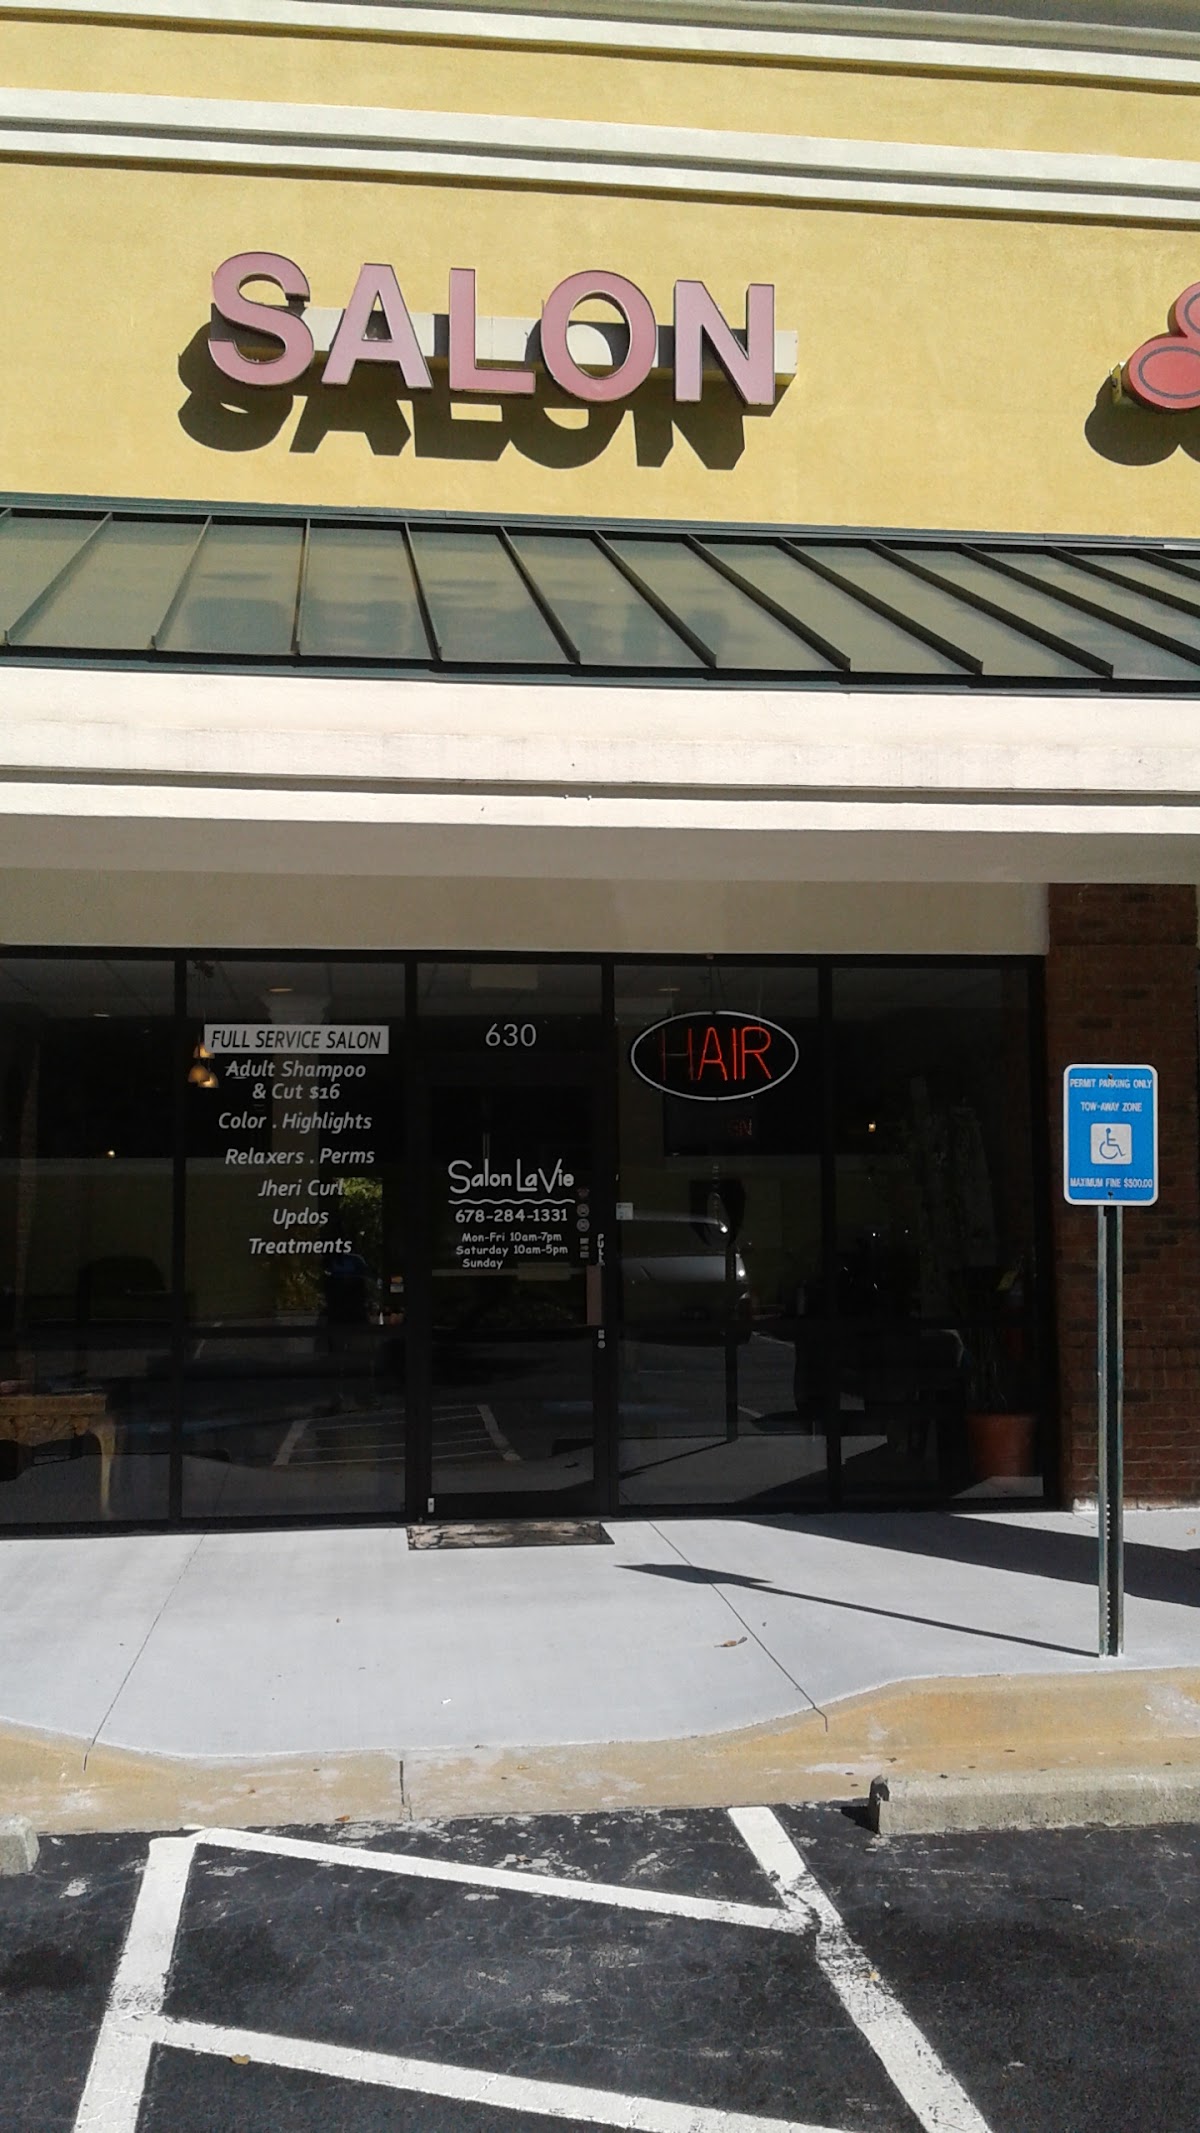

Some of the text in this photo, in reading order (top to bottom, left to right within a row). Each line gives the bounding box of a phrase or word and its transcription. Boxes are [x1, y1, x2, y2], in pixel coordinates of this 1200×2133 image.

[208, 251, 775, 405] SALON
[211, 1030, 381, 1049] FULL SERVICE SALON
[485, 1023, 537, 1047] 630
[661, 1026, 772, 1081] HAIR
[225, 1059, 366, 1082] Adult Shampoo
[252, 1083, 341, 1099] & Cut $16
[1070, 1078, 1152, 1089] PERMIT PARKING ONLY
[1080, 1101, 1142, 1112] TOW-AWAY ZONE
[218, 1111, 373, 1134] Color Highlights
[225, 1147, 375, 1165] Relaxers Perms
[448, 1158, 512, 1194] Salon
[1070, 1177, 1153, 1188] MAXIMUM FINE $500.00
[258, 1178, 344, 1197] Jheri Curl
[273, 1207, 329, 1230] Updos
[455, 1208, 568, 1223] 678-284-1331
[249, 1237, 352, 1254] Treatments
[461, 1232, 562, 1244] Mon-Fri 10am-7pm
[456, 1245, 509, 1257] Saturday
[513, 1244, 568, 1256] 10am-5pm
[462, 1258, 503, 1269] Sunday
